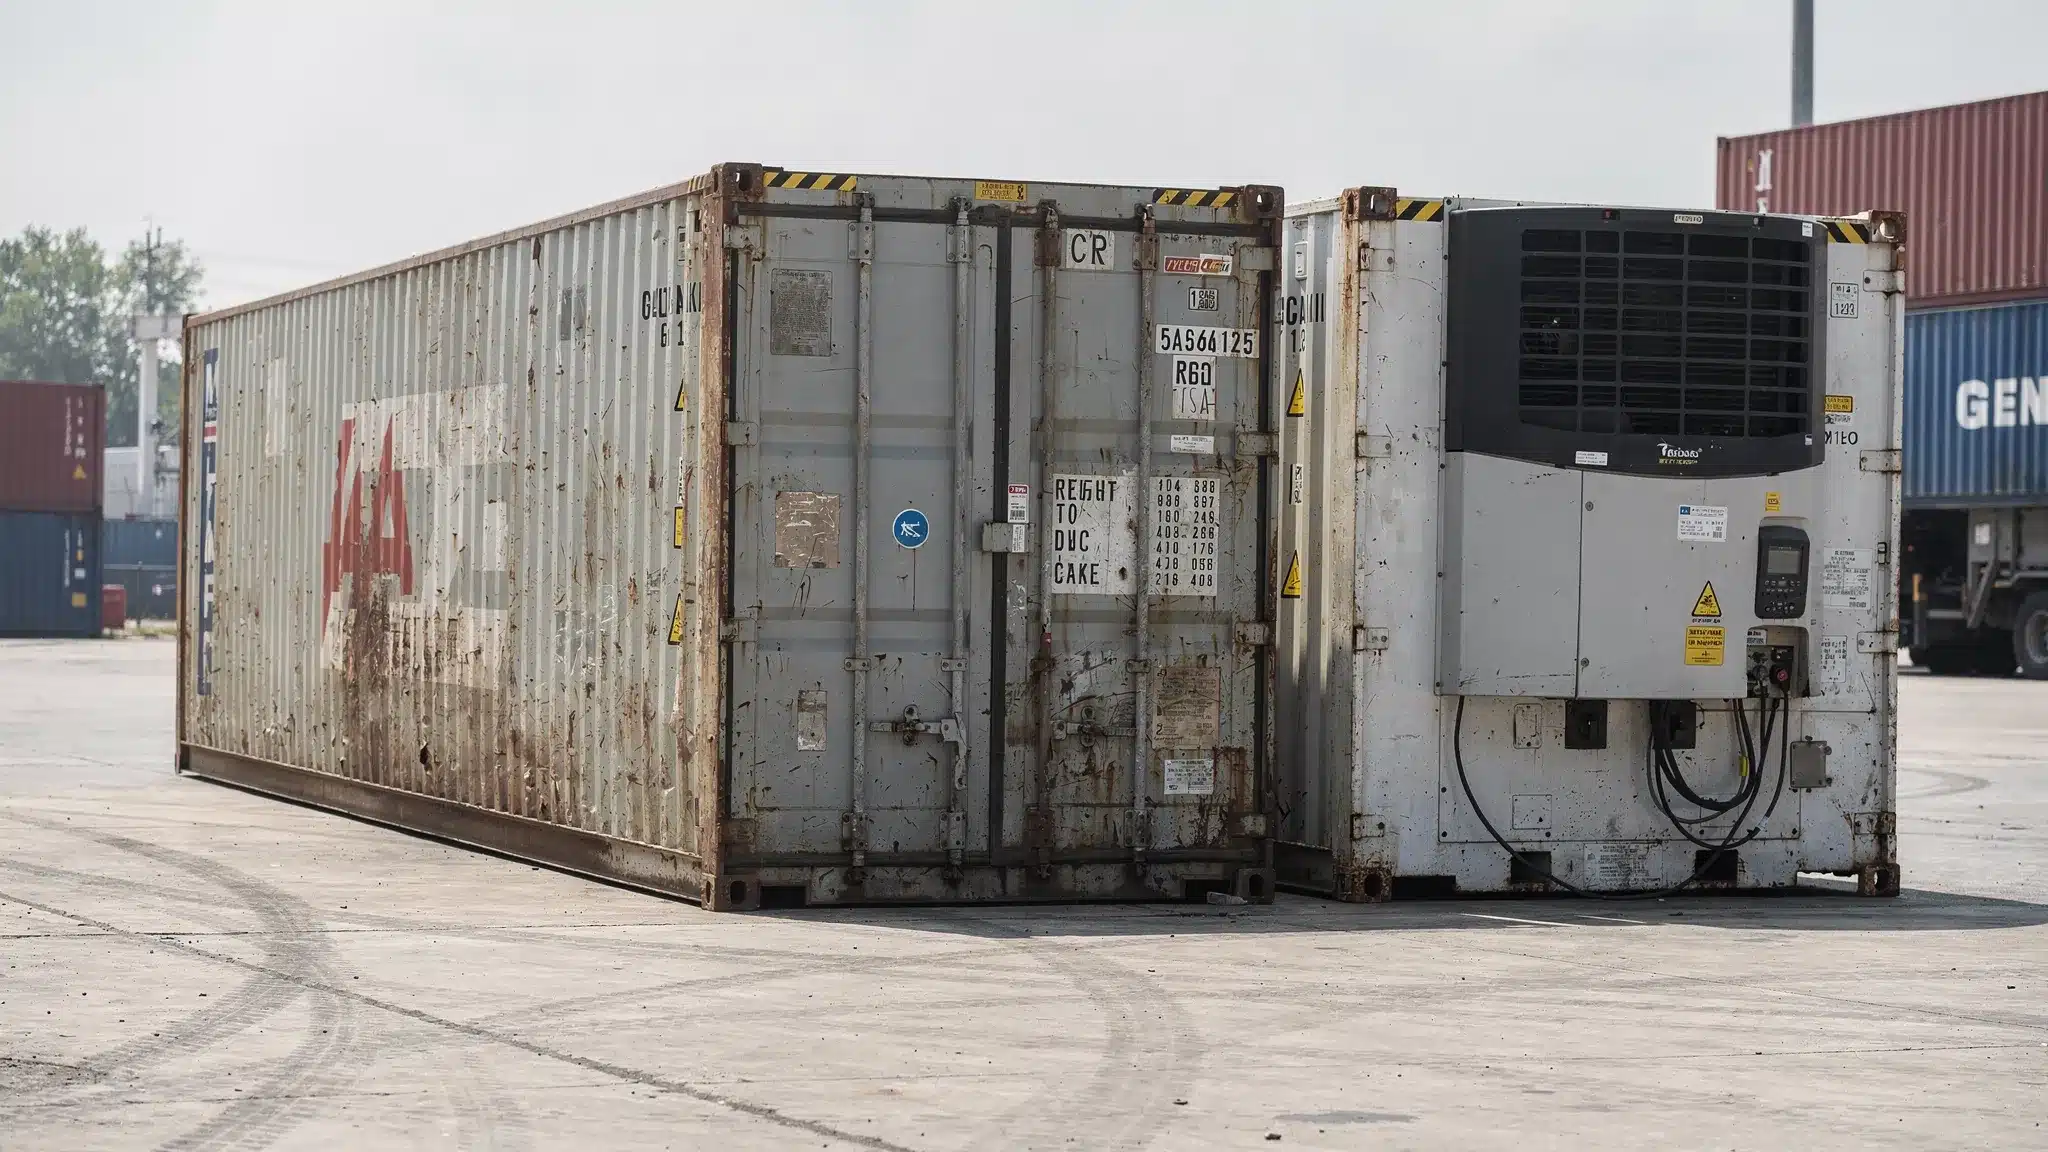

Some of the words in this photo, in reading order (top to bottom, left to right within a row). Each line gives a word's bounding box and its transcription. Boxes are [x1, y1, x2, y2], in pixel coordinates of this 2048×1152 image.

[1071, 233, 1107, 265] CR
[1956, 376, 2048, 430] GEN
[1056, 503, 1078, 525] TO
[1192, 542, 1214, 556] 176
[1054, 561, 1100, 585] CAKE
[1190, 573, 1213, 587] 408
